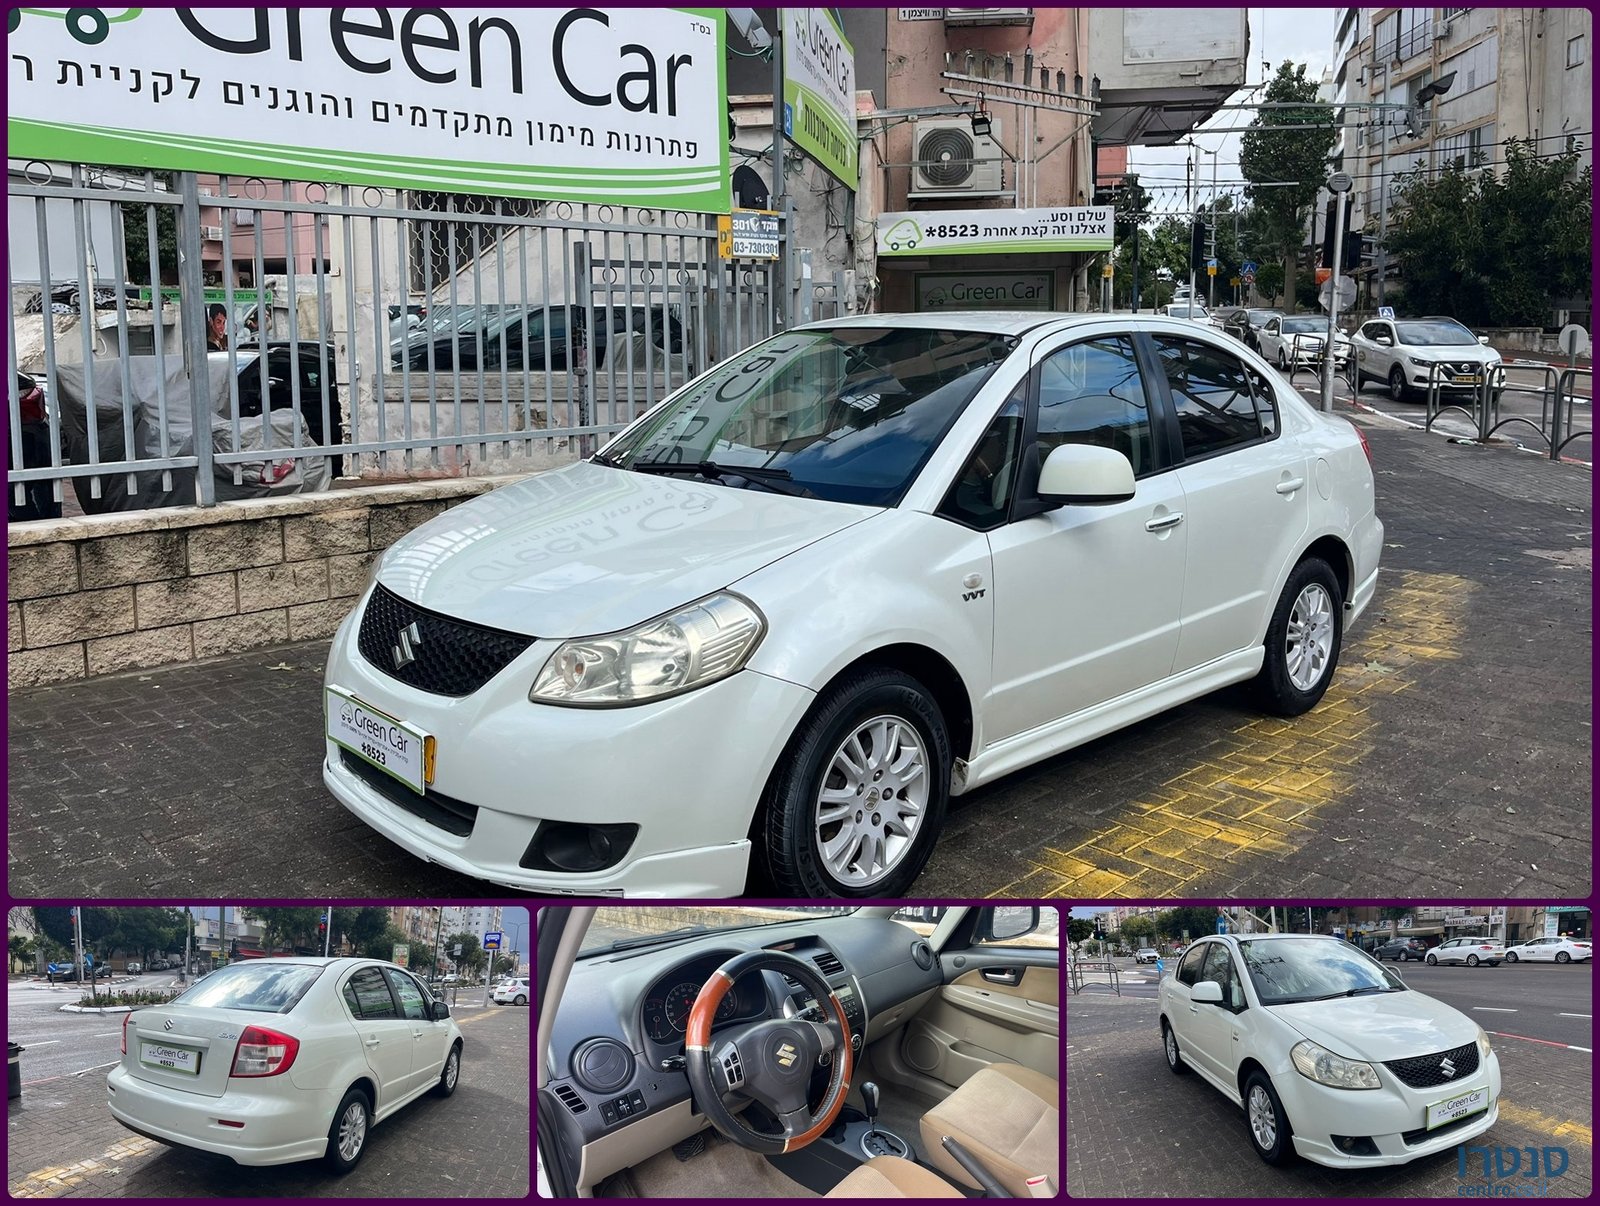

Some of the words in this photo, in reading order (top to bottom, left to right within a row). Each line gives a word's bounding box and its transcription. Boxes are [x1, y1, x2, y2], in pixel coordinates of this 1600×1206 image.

[552, 8, 693, 117] Car
[57, 59, 201, 103] לקניית
[223, 80, 353, 118] והוגנים
[371, 100, 513, 138] מתקדמים
[526, 120, 594, 146] מימון
[606, 131, 698, 159] פתרונות
[1077, 210, 1106, 222] שלם
[732, 219, 750, 231] 301
[983, 226, 1017, 237] אחרת
[1022, 225, 1048, 238] קצת
[1052, 223, 1067, 235] זה
[1070, 222, 1106, 235] אצלנו
[734, 242, 778, 255] 03-7301301
[951, 283, 1006, 300] Green
[1011, 281, 1043, 299] Car
[961, 589, 986, 602] VVT
[354, 708, 387, 742] Green
[389, 726, 408, 754] Car
[156, 1047, 177, 1058] Green
[177, 1050, 189, 1061] Car
[1447, 1097, 1469, 1110] Green
[1469, 1092, 1482, 1103] Car
